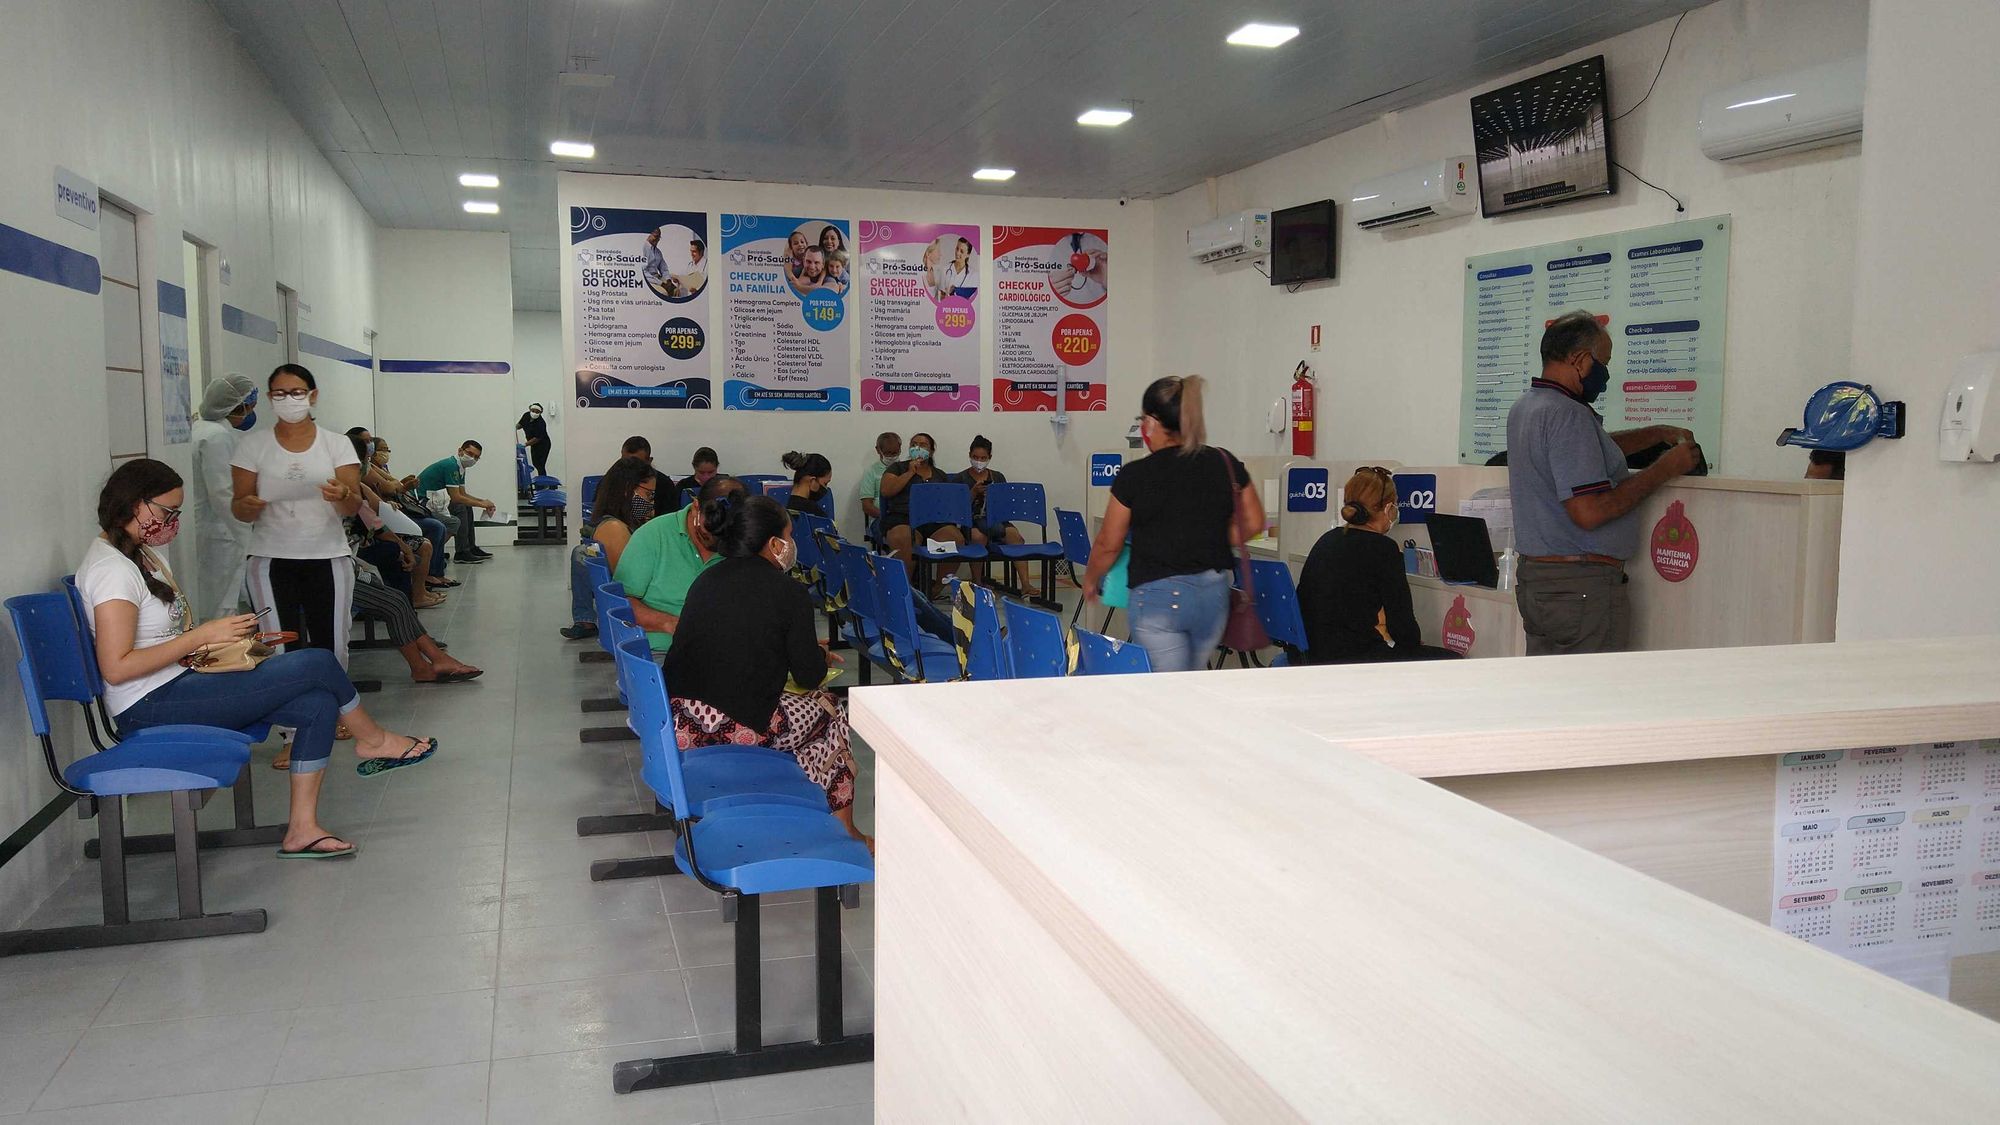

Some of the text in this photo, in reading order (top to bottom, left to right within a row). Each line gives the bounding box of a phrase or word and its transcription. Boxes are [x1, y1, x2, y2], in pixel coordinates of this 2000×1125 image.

[58, 184, 96, 213] preventivo
[596, 254, 647, 264] Pró-Saúde
[582, 269, 635, 278] CHECKUP
[730, 272, 778, 281] CHECKUP
[583, 278, 643, 288] DO HOMEM
[870, 278, 917, 287] CHECKUP
[999, 281, 1044, 290] CHECKUP
[730, 283, 785, 294] DA FAMÍLIA
[871, 288, 925, 297] DA MULHER
[999, 292, 1050, 302] CARDIOLÓGICO
[734, 299, 768, 307] Hemograma
[813, 307, 835, 320] 149
[945, 315, 966, 327] 299
[677, 327, 698, 335] APENAS
[671, 335, 694, 349] 299
[1064, 337, 1089, 352] 220
[1104, 465, 1120, 476] 06
[1305, 482, 1325, 499] 03
[1410, 491, 1434, 509] 02
[1657, 548, 1691, 560] MANTENHA
[1657, 556, 1689, 568] DISTÂNCIA
[1447, 632, 1470, 642] MANTENHA
[1933, 742, 1954, 750] MARÇO
[1801, 752, 1826, 761] JANEIRO
[1864, 747, 1896, 756] FEVEREIRO
[1932, 810, 1949, 818] JULHO
[1867, 816, 1886, 824] JUNHO
[1803, 823, 1818, 832] MAIO
[1921, 878, 1953, 888] NOVEMBRO
[1860, 886, 1888, 895] OUTUBRO
[1793, 894, 1825, 904] SETEMBRO
